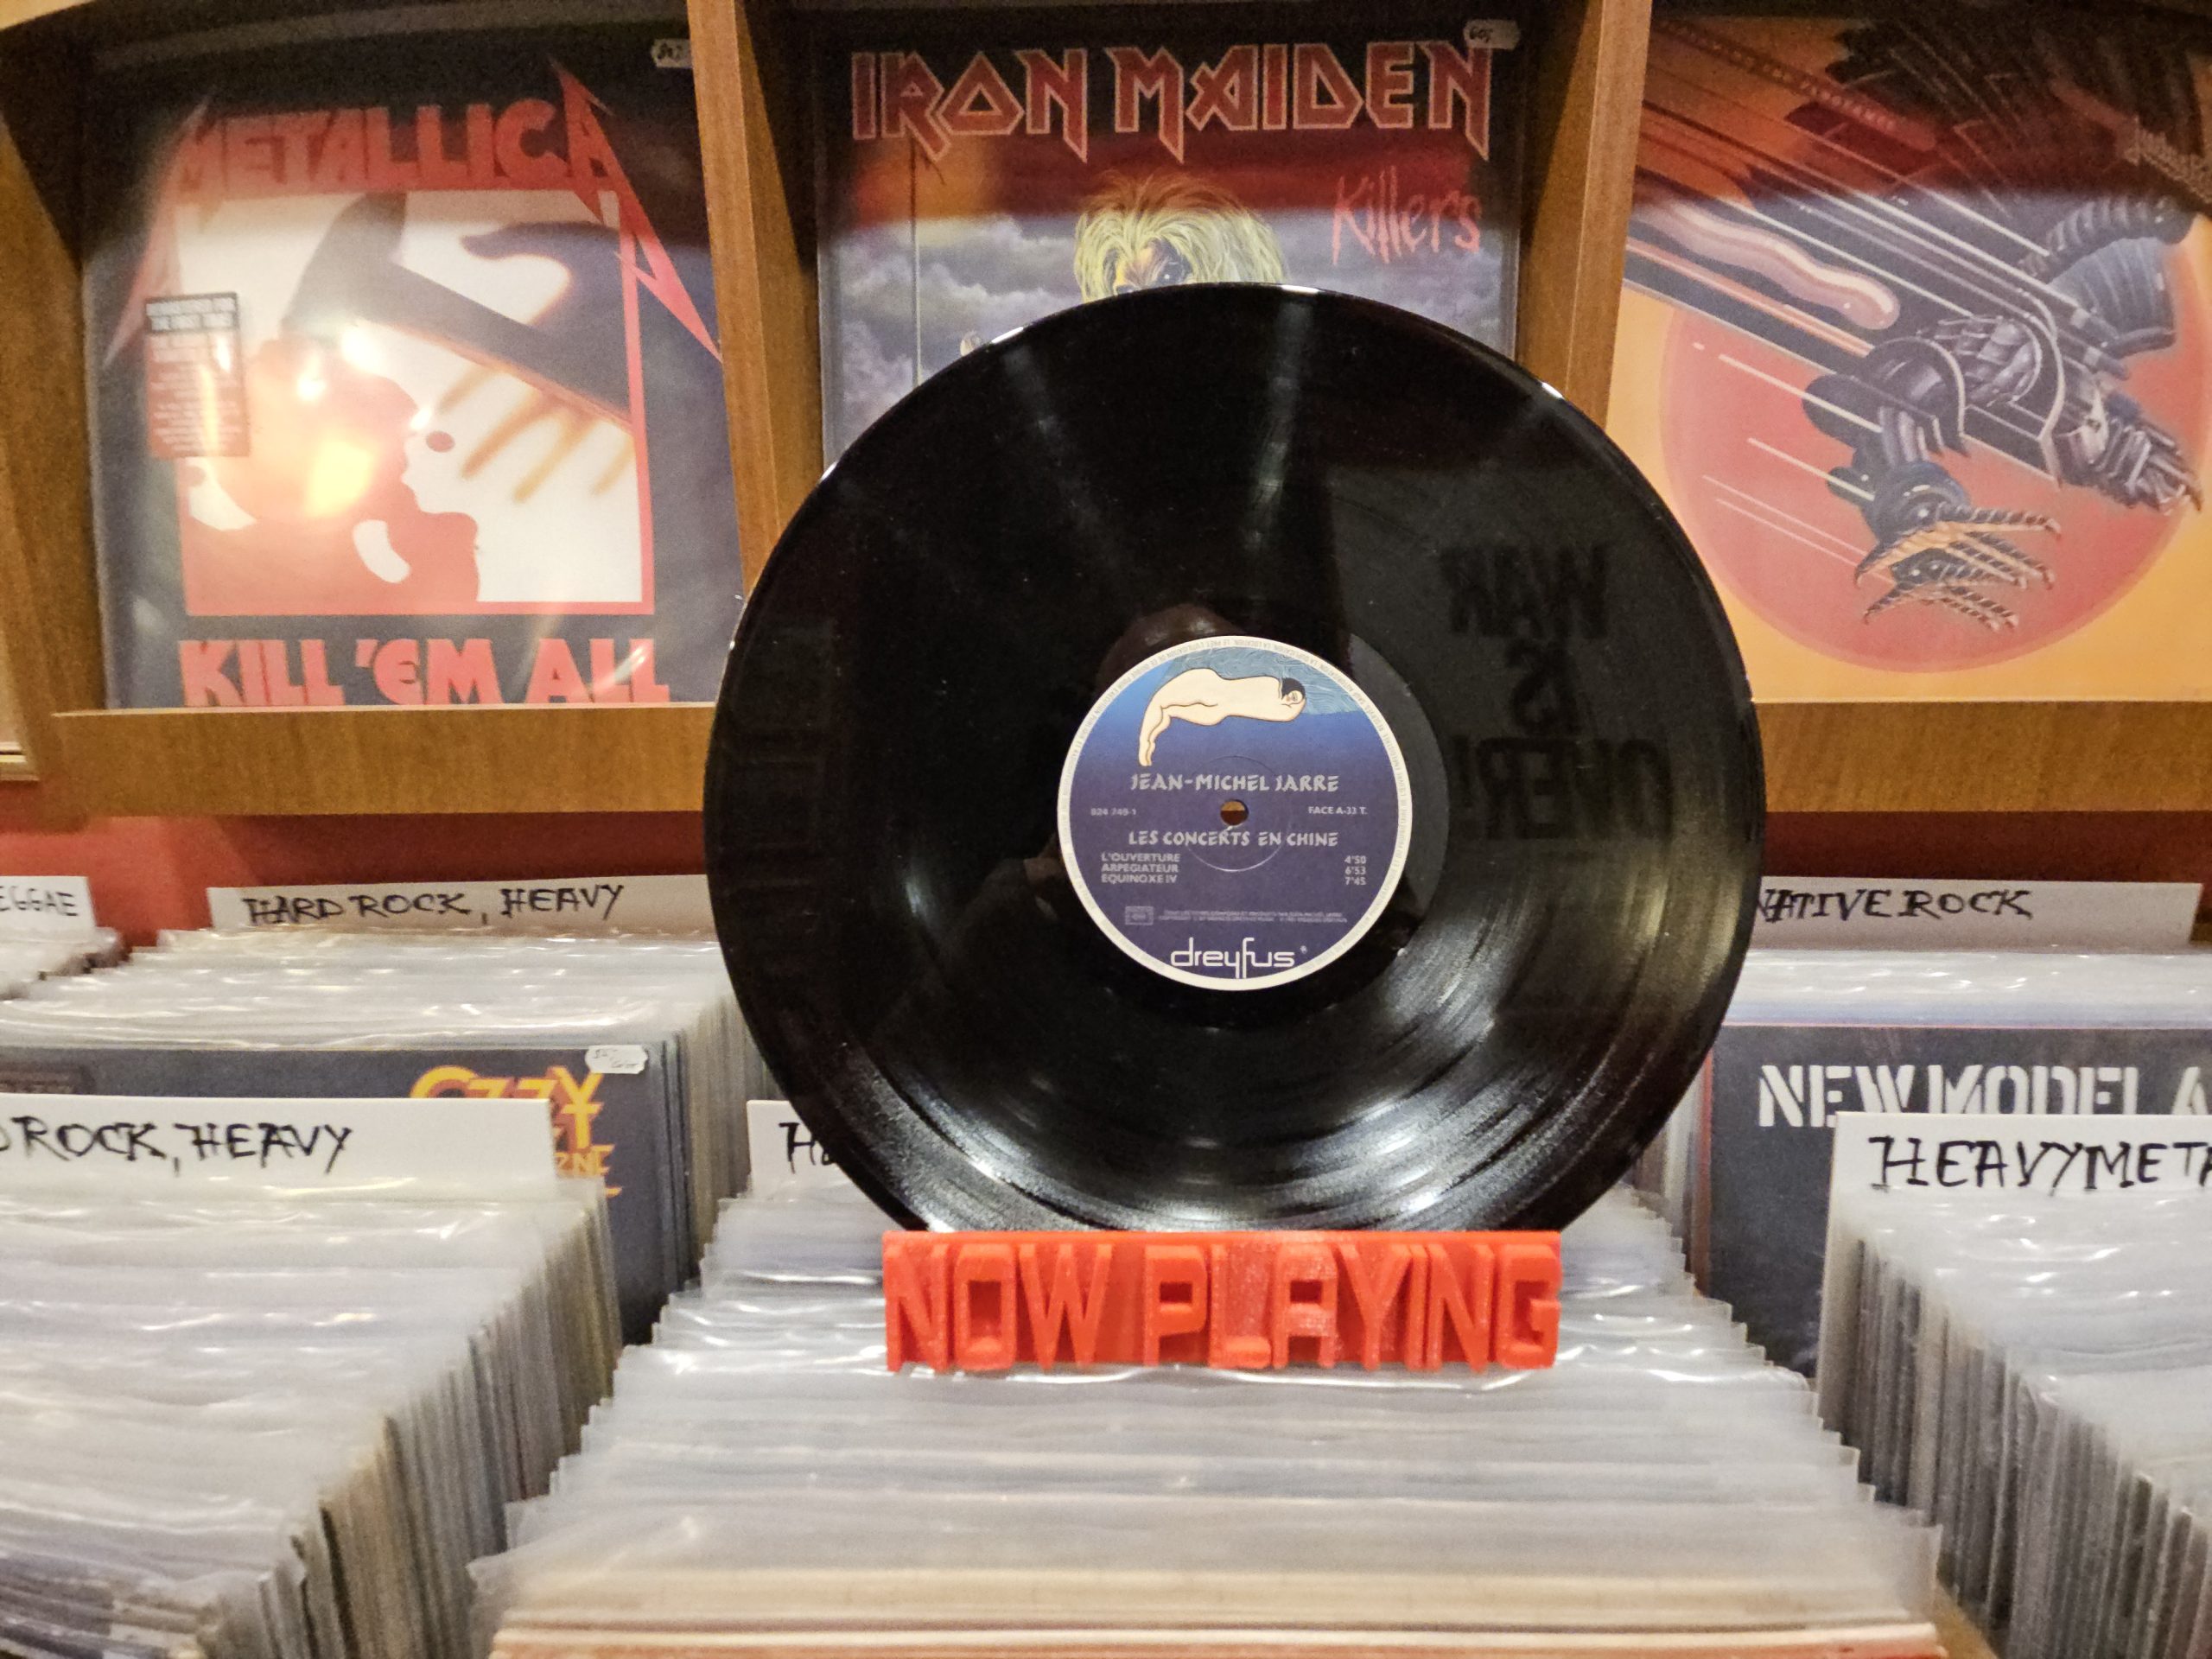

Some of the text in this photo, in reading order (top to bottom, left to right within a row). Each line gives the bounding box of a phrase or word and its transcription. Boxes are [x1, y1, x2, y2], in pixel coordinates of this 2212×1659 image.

[851, 41, 1491, 162] IRON MAIDEN
[1332, 165, 1481, 264] Killers
[177, 639, 670, 707] KILL 'EM ALL
[1130, 773, 1339, 791] JEAN-MICHEL JARRE
[1101, 852, 1181, 862] L'OUVERTURE
[1128, 830, 1338, 847] LES CONCERTS EN CHINE
[1101, 874, 1164, 884] EQUINOXE
[242, 895, 344, 926] HARD
[499, 884, 625, 921] HEAVY
[1897, 889, 2033, 920] ROCK
[1171, 937, 1295, 979] dreyfus
[1758, 1065, 1916, 1128] NEW
[175, 1122, 353, 1175] HEAVY
[883, 1243, 1562, 1374] NOW PLAYING
